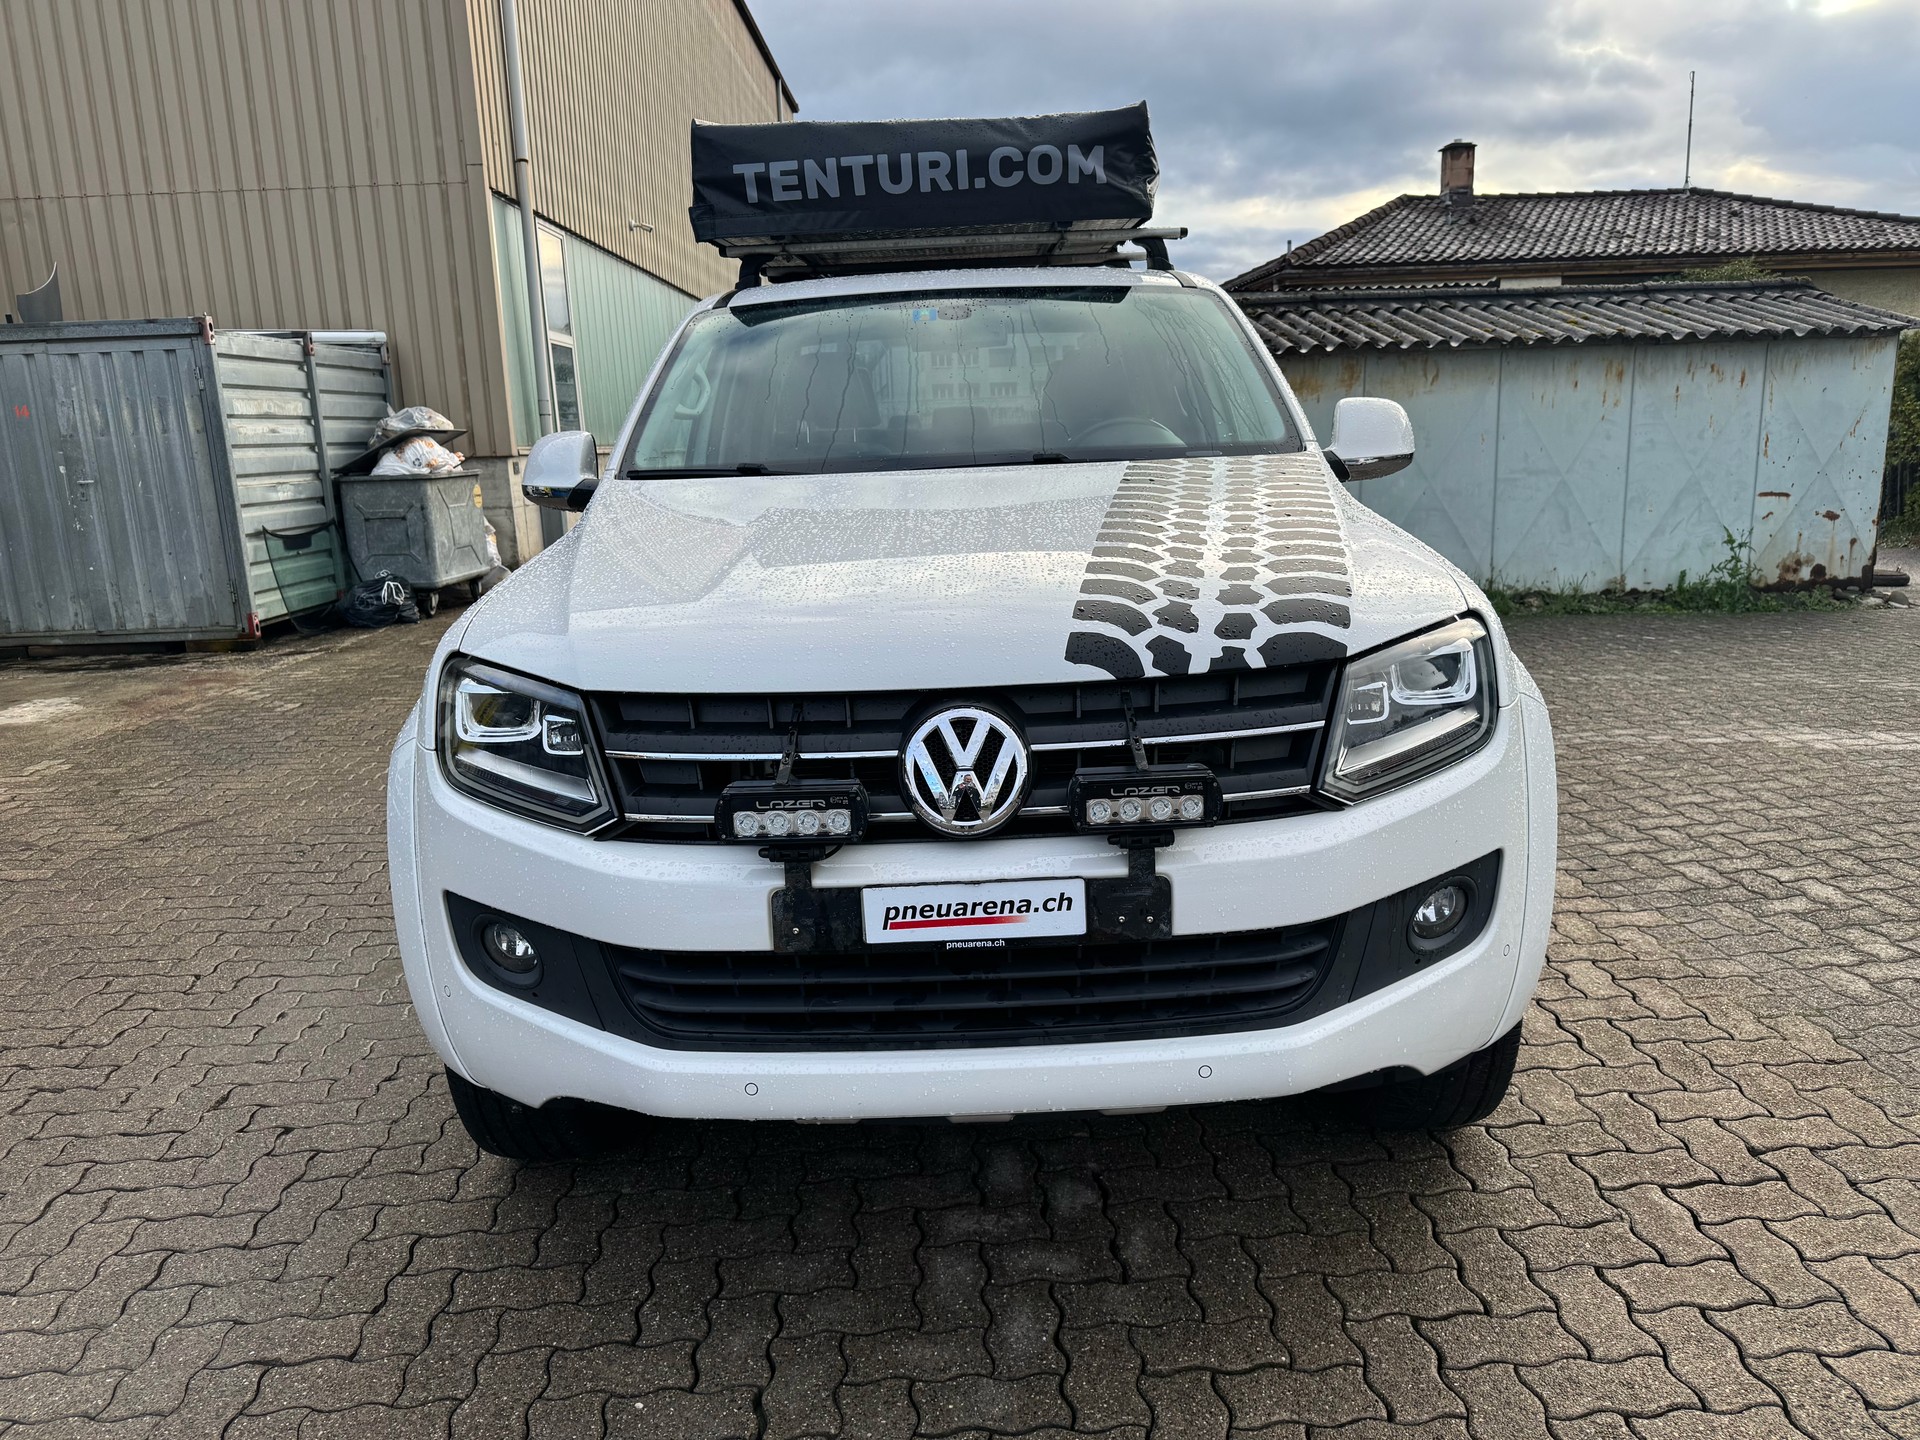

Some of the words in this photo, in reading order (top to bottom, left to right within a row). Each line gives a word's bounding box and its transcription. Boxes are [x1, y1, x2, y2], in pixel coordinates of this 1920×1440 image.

[732, 144, 1108, 204] TENTURI.COM
[882, 892, 1073, 931] pneuarena.ch
[946, 939, 1006, 950] pneuarena.ch
